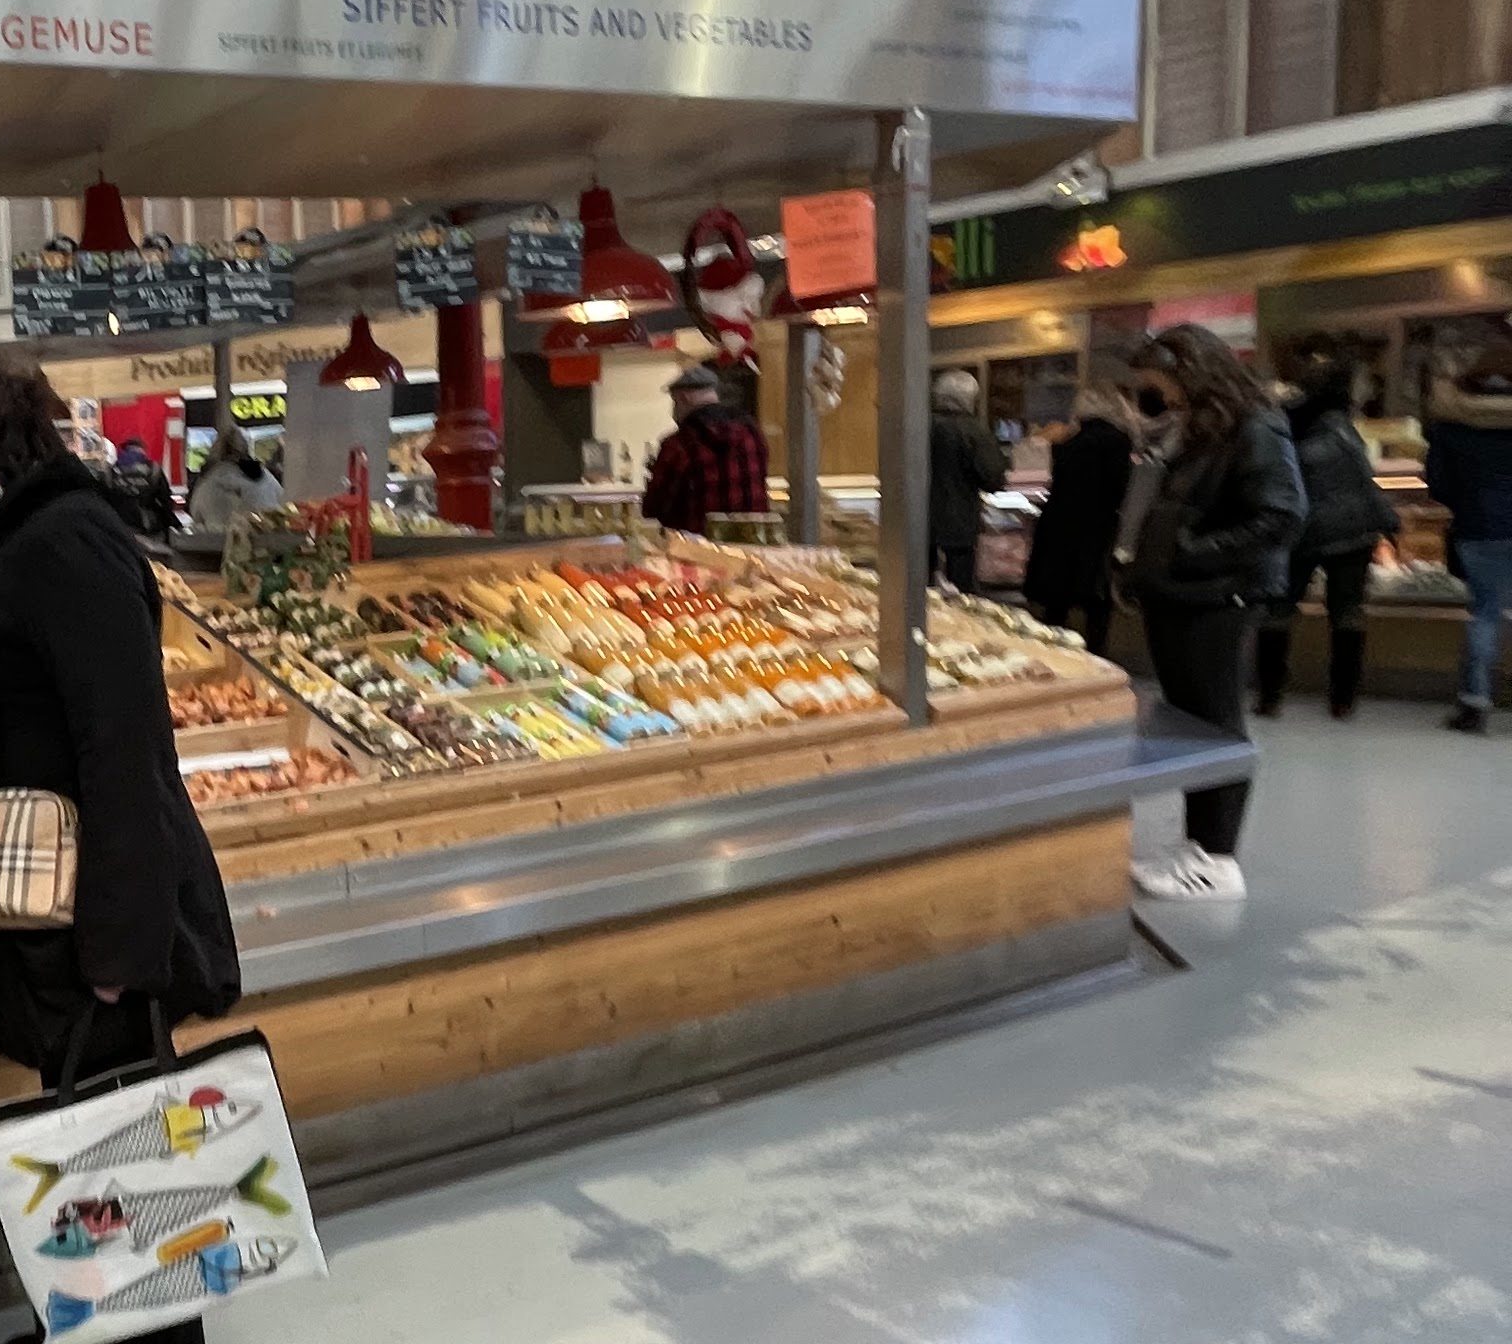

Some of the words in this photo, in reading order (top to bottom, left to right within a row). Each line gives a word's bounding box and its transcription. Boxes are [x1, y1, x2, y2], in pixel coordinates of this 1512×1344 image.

[0, 14, 153, 57] GEMUSE
[590, 6, 647, 42] AND
[653, 10, 814, 53] VEGETABLES
